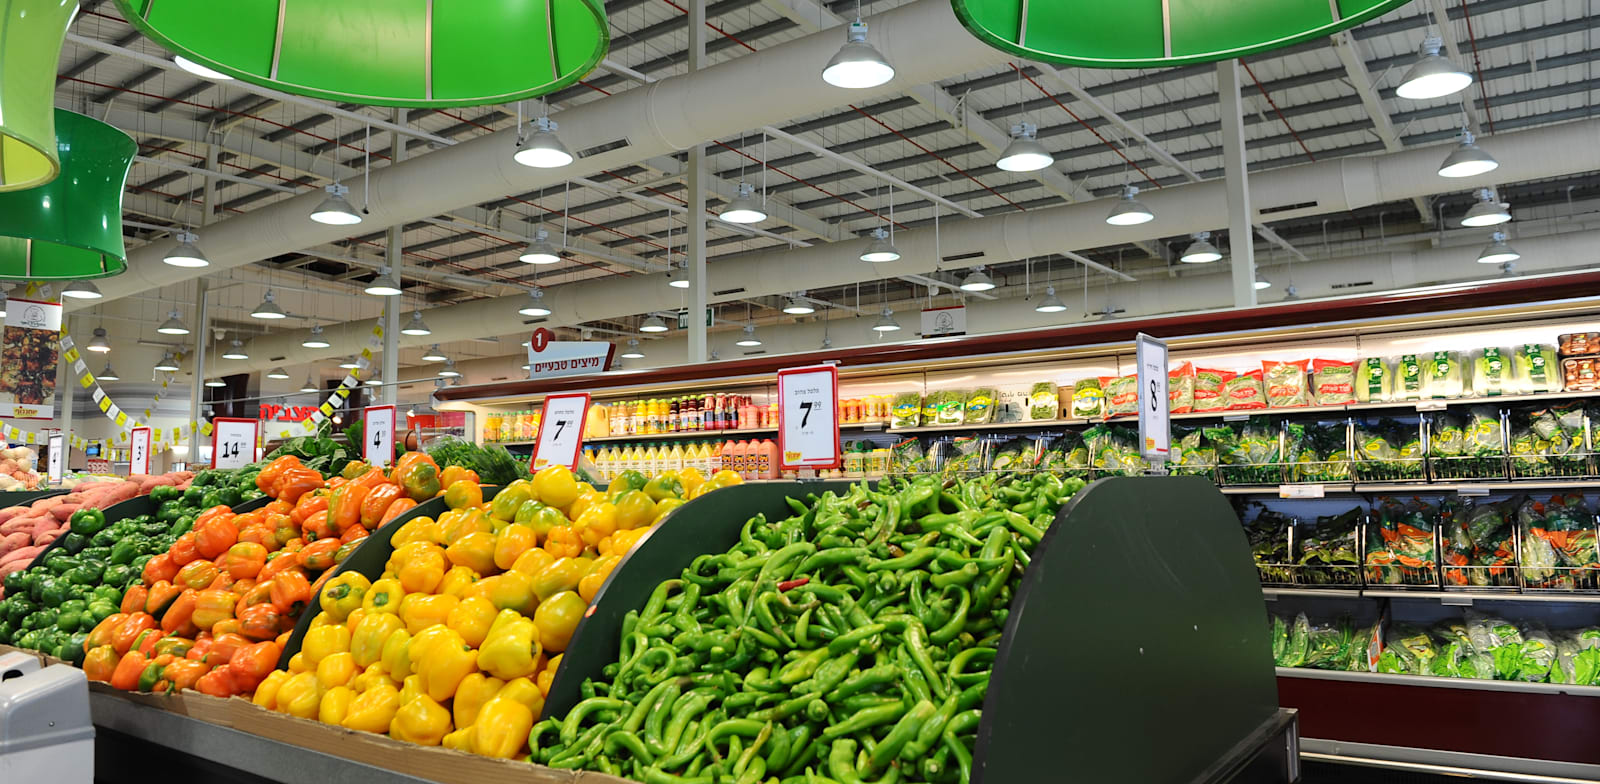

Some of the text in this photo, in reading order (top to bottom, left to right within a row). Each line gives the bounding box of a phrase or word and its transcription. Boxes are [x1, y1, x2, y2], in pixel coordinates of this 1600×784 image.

[535, 332, 542, 347] 1
[535, 357, 599, 373] מיצים טבעיים
[1150, 379, 1158, 412] 8
[799, 401, 822, 428] 7 99
[374, 430, 381, 449] 4
[553, 420, 567, 441] 7
[222, 441, 239, 458] 14
